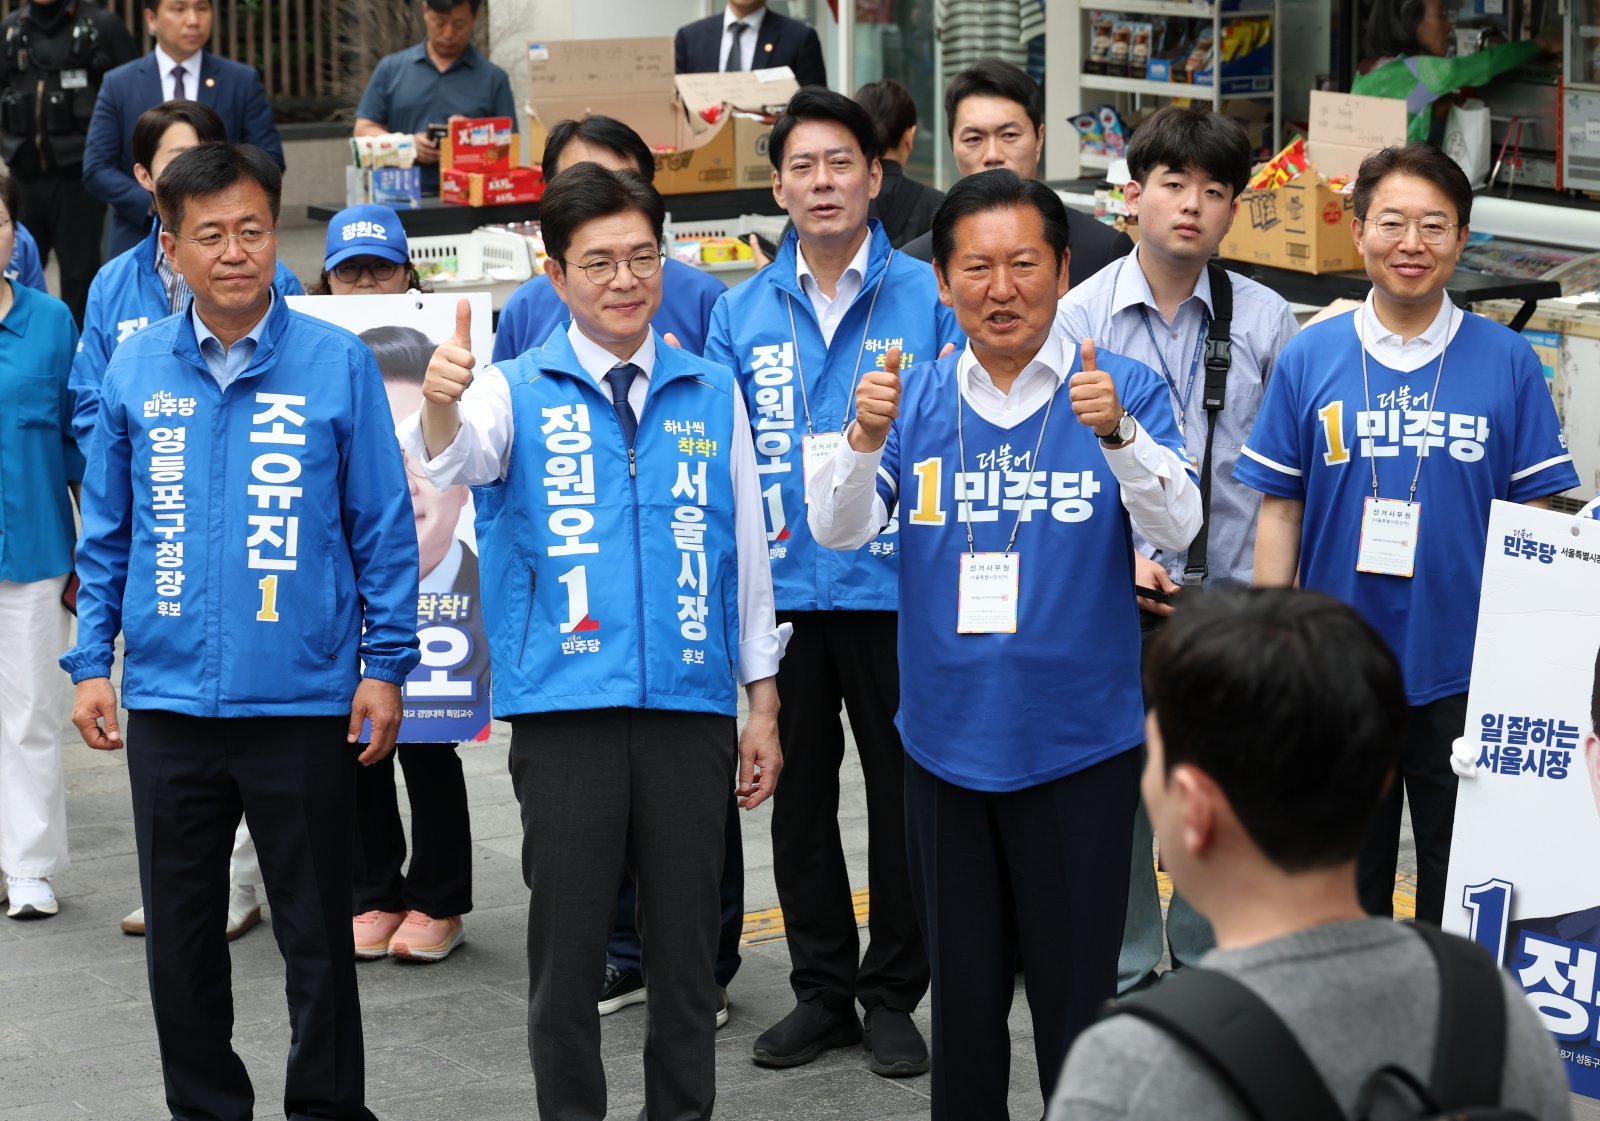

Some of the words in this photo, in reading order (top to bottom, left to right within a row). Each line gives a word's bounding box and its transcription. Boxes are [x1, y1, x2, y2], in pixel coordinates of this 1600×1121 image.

[342, 221, 387, 241] 정원오
[144, 398, 197, 417] 민주당
[751, 341, 795, 475] 정원오
[1377, 385, 1429, 412] 더불어
[663, 420, 705, 436] 하나씩
[1318, 400, 1350, 467] 1
[1356, 410, 1490, 463] 민주당
[678, 438, 717, 457] 착착!
[811, 442, 838, 450] 선거사무
[976, 443, 1031, 474] 더불어
[247, 392, 306, 570] 조유진
[540, 403, 600, 557] 정원오
[909, 457, 946, 526] 1
[954, 471, 1101, 523] 민주당
[149, 426, 186, 597] 영등포구청장
[1373, 509, 1411, 520] 선거사무원
[670, 461, 708, 641] 서울시장
[868, 541, 894, 556] 후보
[1504, 535, 1557, 564] 민주당
[970, 564, 1010, 572] 선거사무원
[157, 601, 181, 617] 후보
[256, 574, 279, 622] 1
[417, 594, 469, 620] 착착!
[558, 565, 600, 633] 1
[406, 626, 472, 697] 오
[561, 638, 601, 655] 민주당
[682, 649, 704, 665] 후보
[1476, 746, 1572, 780] 서울시장
[1462, 878, 1514, 970] 1
[1518, 936, 1600, 1041] 정
